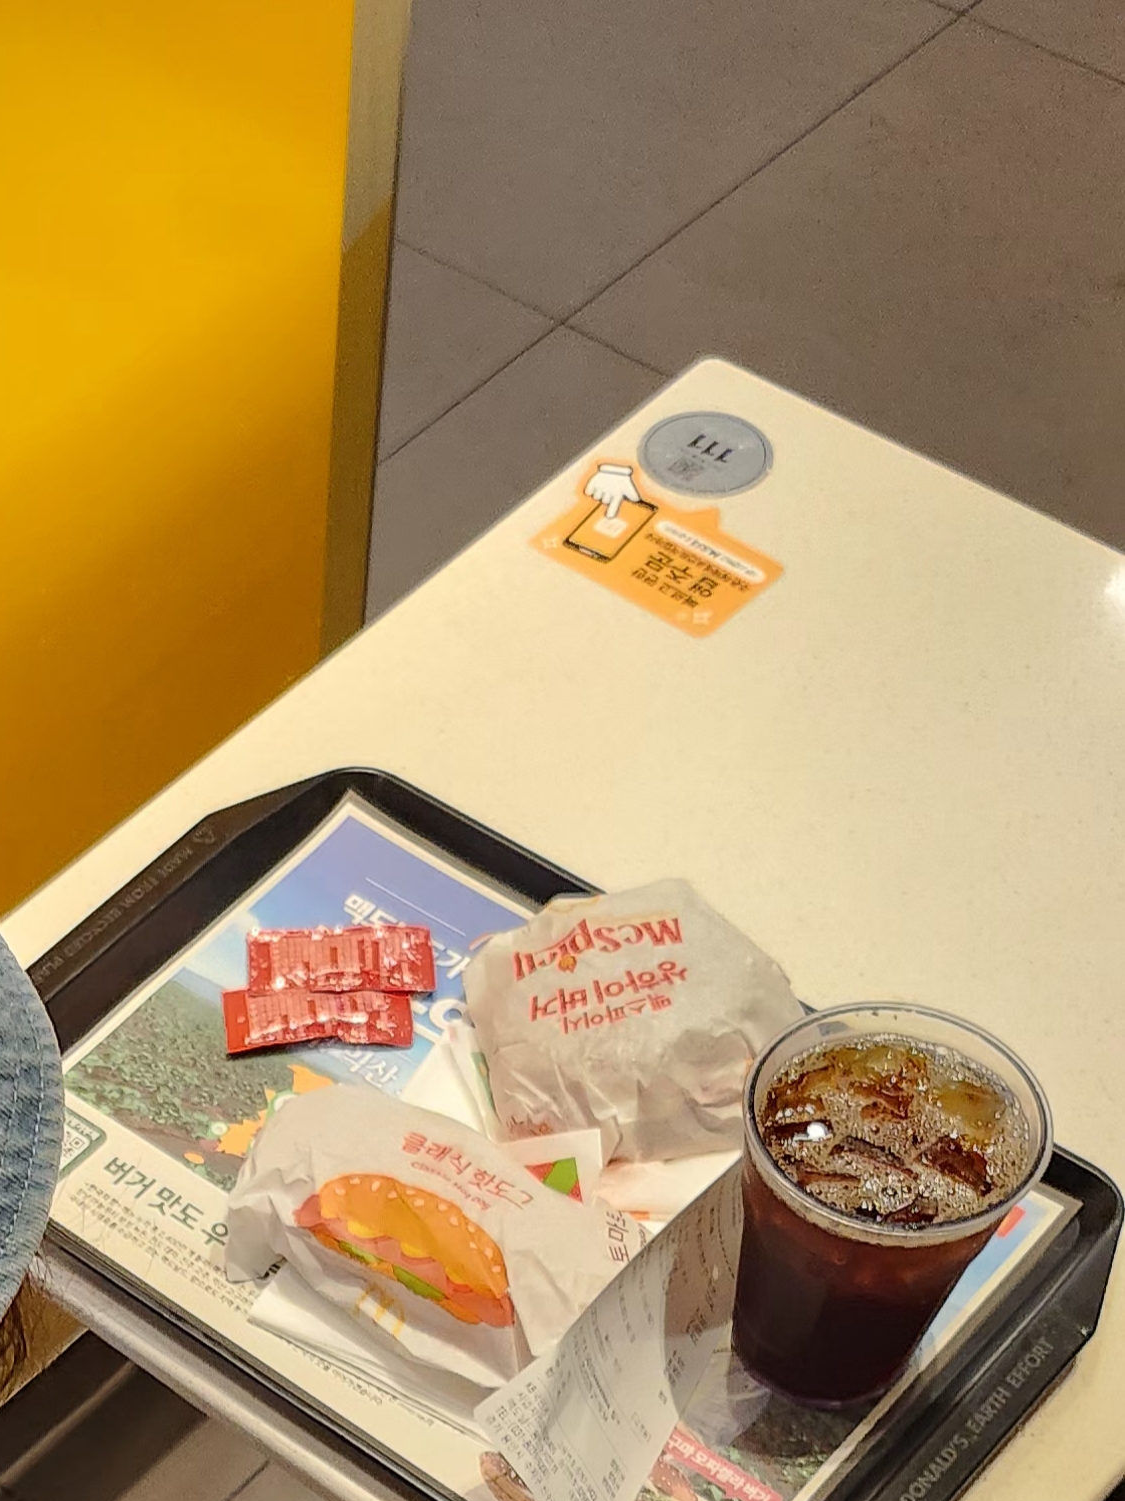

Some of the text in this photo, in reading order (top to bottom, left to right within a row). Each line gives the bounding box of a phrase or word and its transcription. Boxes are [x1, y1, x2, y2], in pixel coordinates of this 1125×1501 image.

[644, 550, 694, 584] 주문
[688, 576, 719, 598] 앱
[514, 917, 683, 982] McSpicy
[529, 961, 688, 1022] 상하이 버거
[559, 993, 672, 1034] 맥스파이시
[103, 1157, 156, 1199] 버거
[148, 1187, 205, 1230] 맛도
[402, 1132, 534, 1210] 클래식 핫도그
[965, 1387, 1012, 1439] EARTH
[1006, 1336, 1055, 1390] EFFORT
